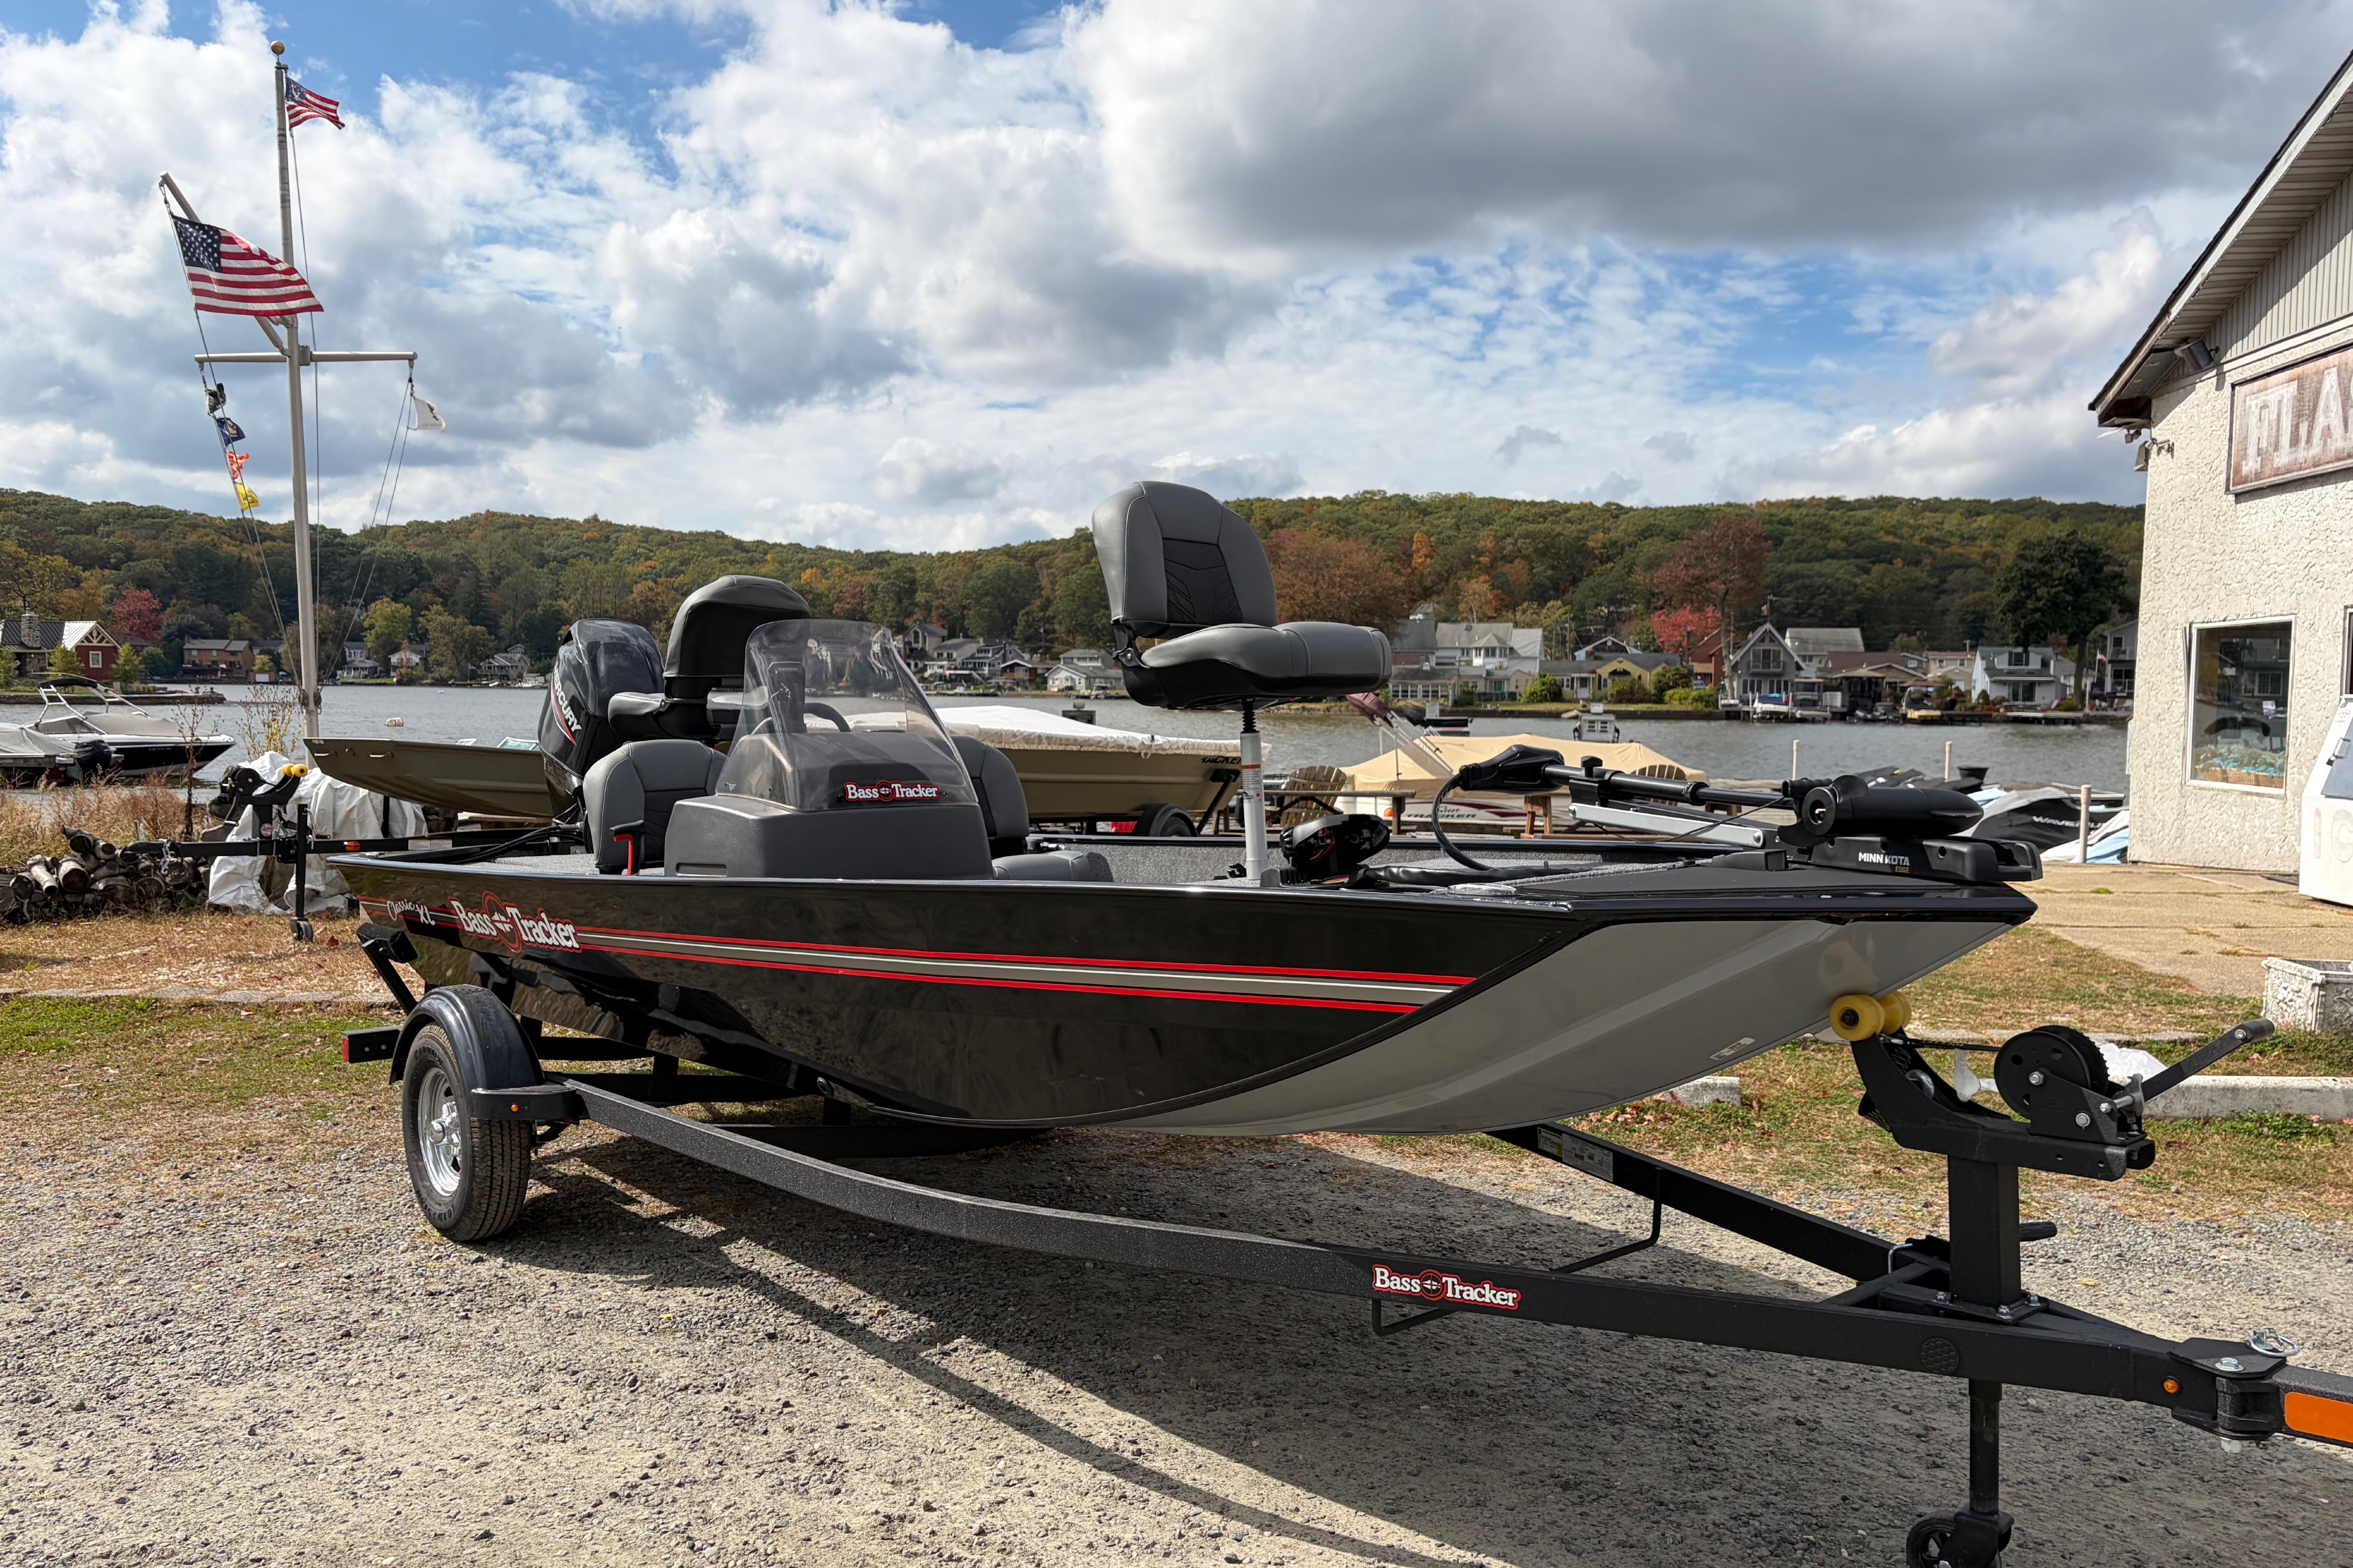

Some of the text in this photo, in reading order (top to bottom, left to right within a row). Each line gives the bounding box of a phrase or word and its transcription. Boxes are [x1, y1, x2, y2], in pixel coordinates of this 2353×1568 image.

[2242, 367, 2353, 476] FLA
[553, 661, 582, 732] MERCURY
[846, 784, 937, 799] Bass Tracker
[1858, 852, 1910, 866] MINN KOTA
[387, 898, 435, 926] Classic XL
[451, 900, 579, 948] Bass Tracker
[1374, 1267, 1517, 1306] Bass Tracker
